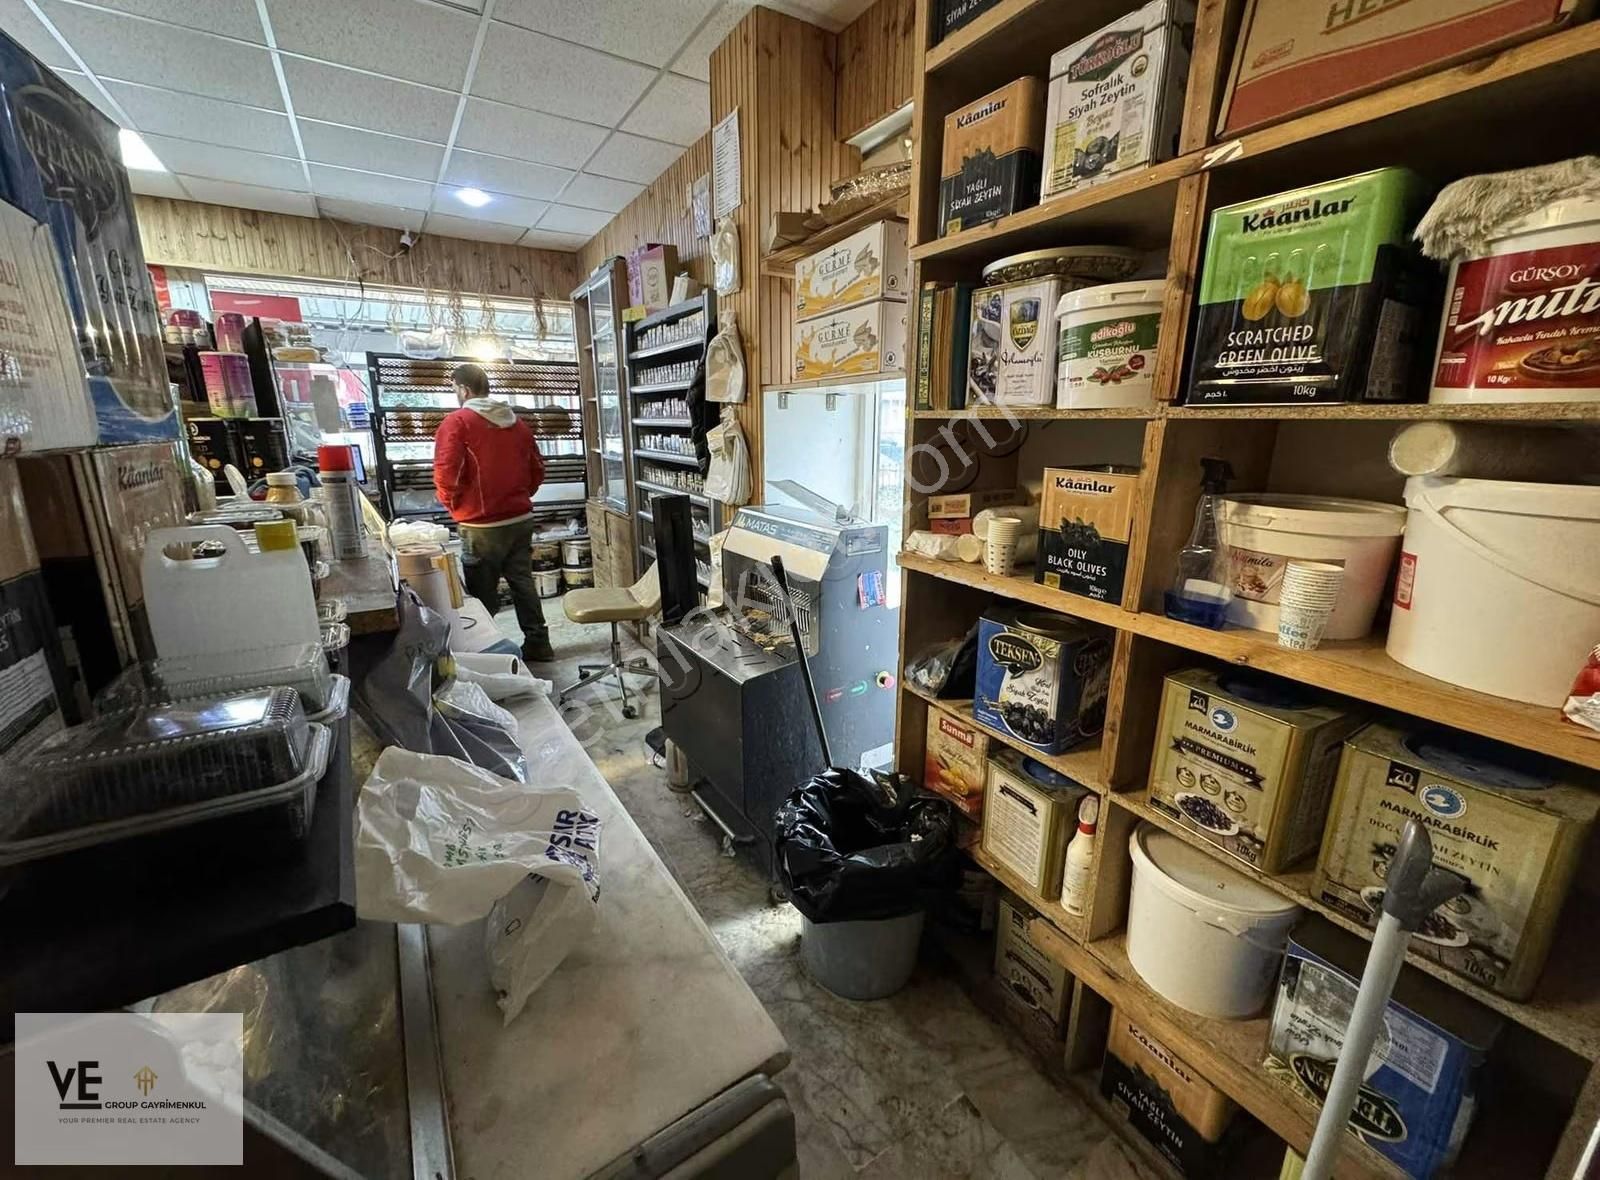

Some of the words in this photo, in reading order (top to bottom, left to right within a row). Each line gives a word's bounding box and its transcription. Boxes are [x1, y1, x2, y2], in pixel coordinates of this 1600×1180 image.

[1081, 74, 1123, 101] Sofralık
[1069, 99, 1096, 119] Siyah
[1100, 83, 1136, 106] Zeytin
[1510, 264, 1582, 283] GÜRSOY
[1227, 325, 1314, 347] SCRATCHED
[1218, 348, 1265, 366] GREEN
[1271, 344, 1318, 361] OLIVE
[1293, 385, 1317, 397] 10kg
[746, 519, 778, 535] MATAS
[1067, 547, 1088, 560] OILY
[1047, 554, 1073, 570] BLACK
[1076, 561, 1108, 577] OLIVES
[993, 639, 1037, 667] TEKSEN
[1184, 720, 1257, 756] MARMARABİRLİK
[1195, 745, 1240, 771] PREMIUM
[1379, 799, 1500, 851] MARMARABİRLİK
[1235, 841, 1258, 863] 10kg
